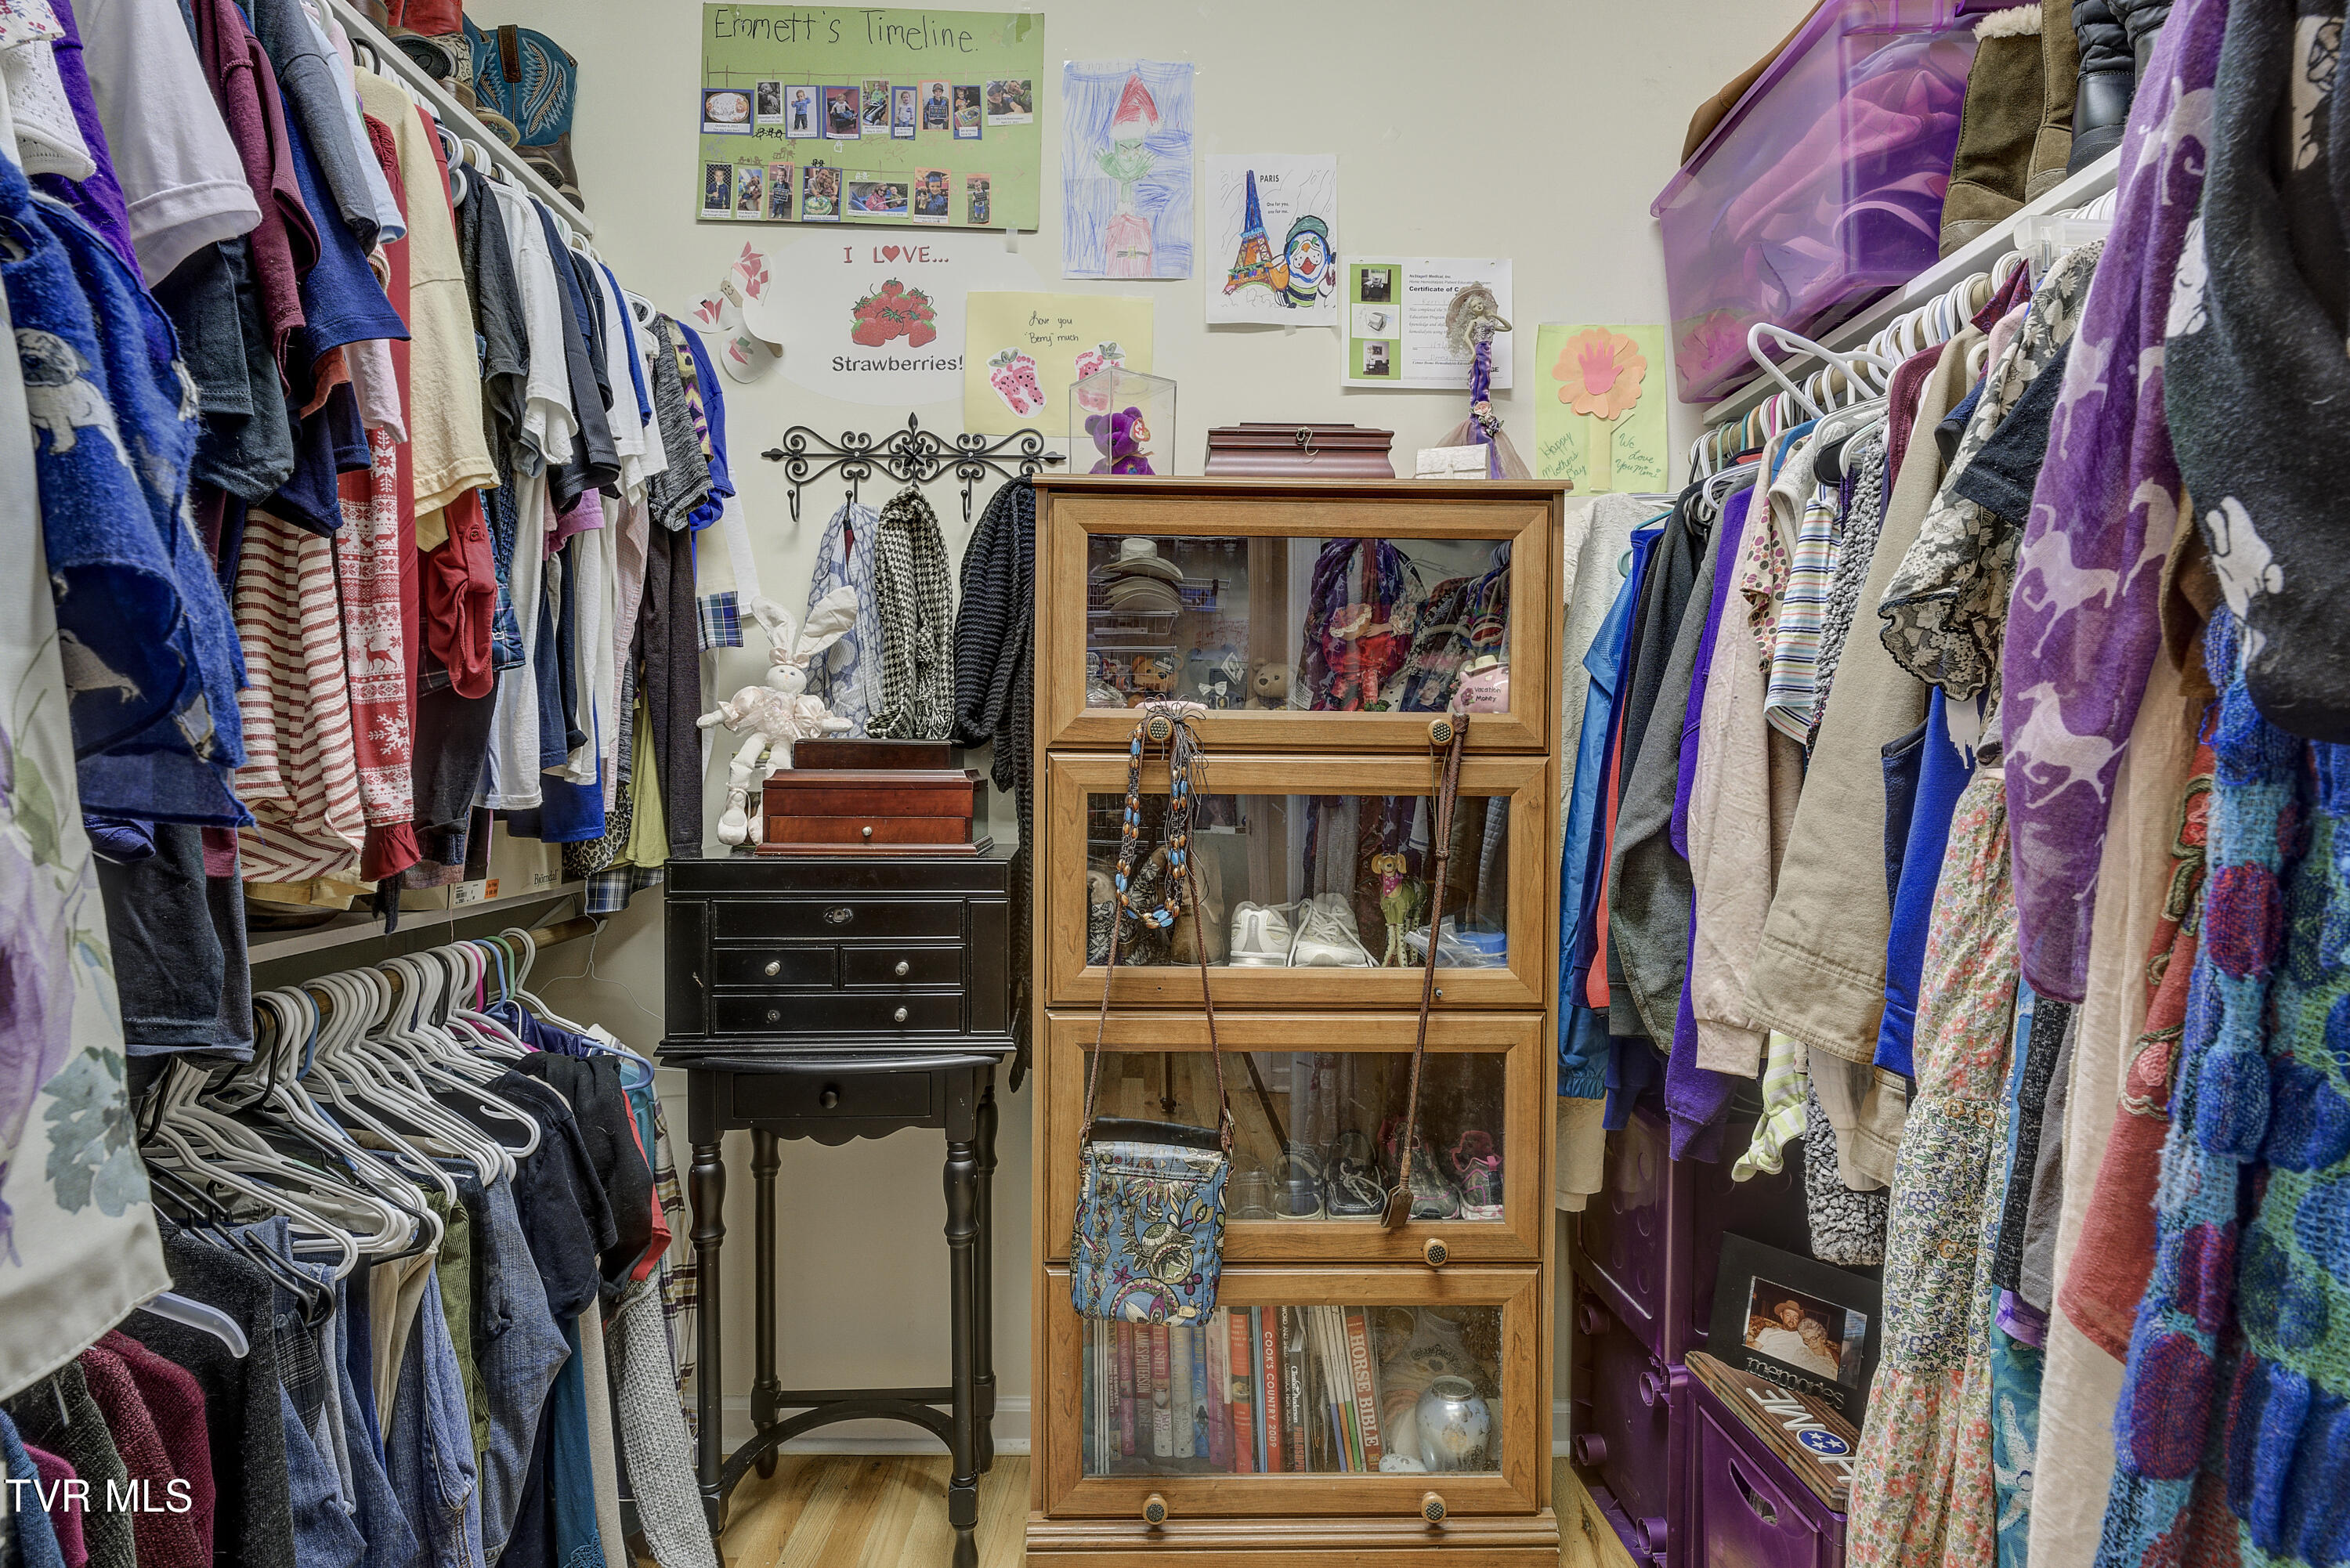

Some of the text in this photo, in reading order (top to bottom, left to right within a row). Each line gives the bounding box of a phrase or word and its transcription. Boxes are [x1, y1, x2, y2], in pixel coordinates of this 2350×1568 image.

[715, 9, 841, 43] Emmett's
[842, 245, 853, 263] I
[1058, 318, 1072, 329] you
[831, 355, 964, 372] Strawberries!
[1539, 432, 1574, 459] Happy
[1629, 450, 1654, 464] Love
[1542, 450, 1579, 480] Mothers
[1567, 464, 1587, 480] Day
[1135, 1330, 1152, 1393] JAMES PATTERSON
[1350, 1333, 1372, 1393] HORSE
[1264, 1331, 1277, 1447] COOK'S COUNTRY 2009
[1290, 1365, 1300, 1423] Clinton Anderson
[1746, 1357, 1845, 1411] memories
[1358, 1395, 1379, 1447] BIBLE
